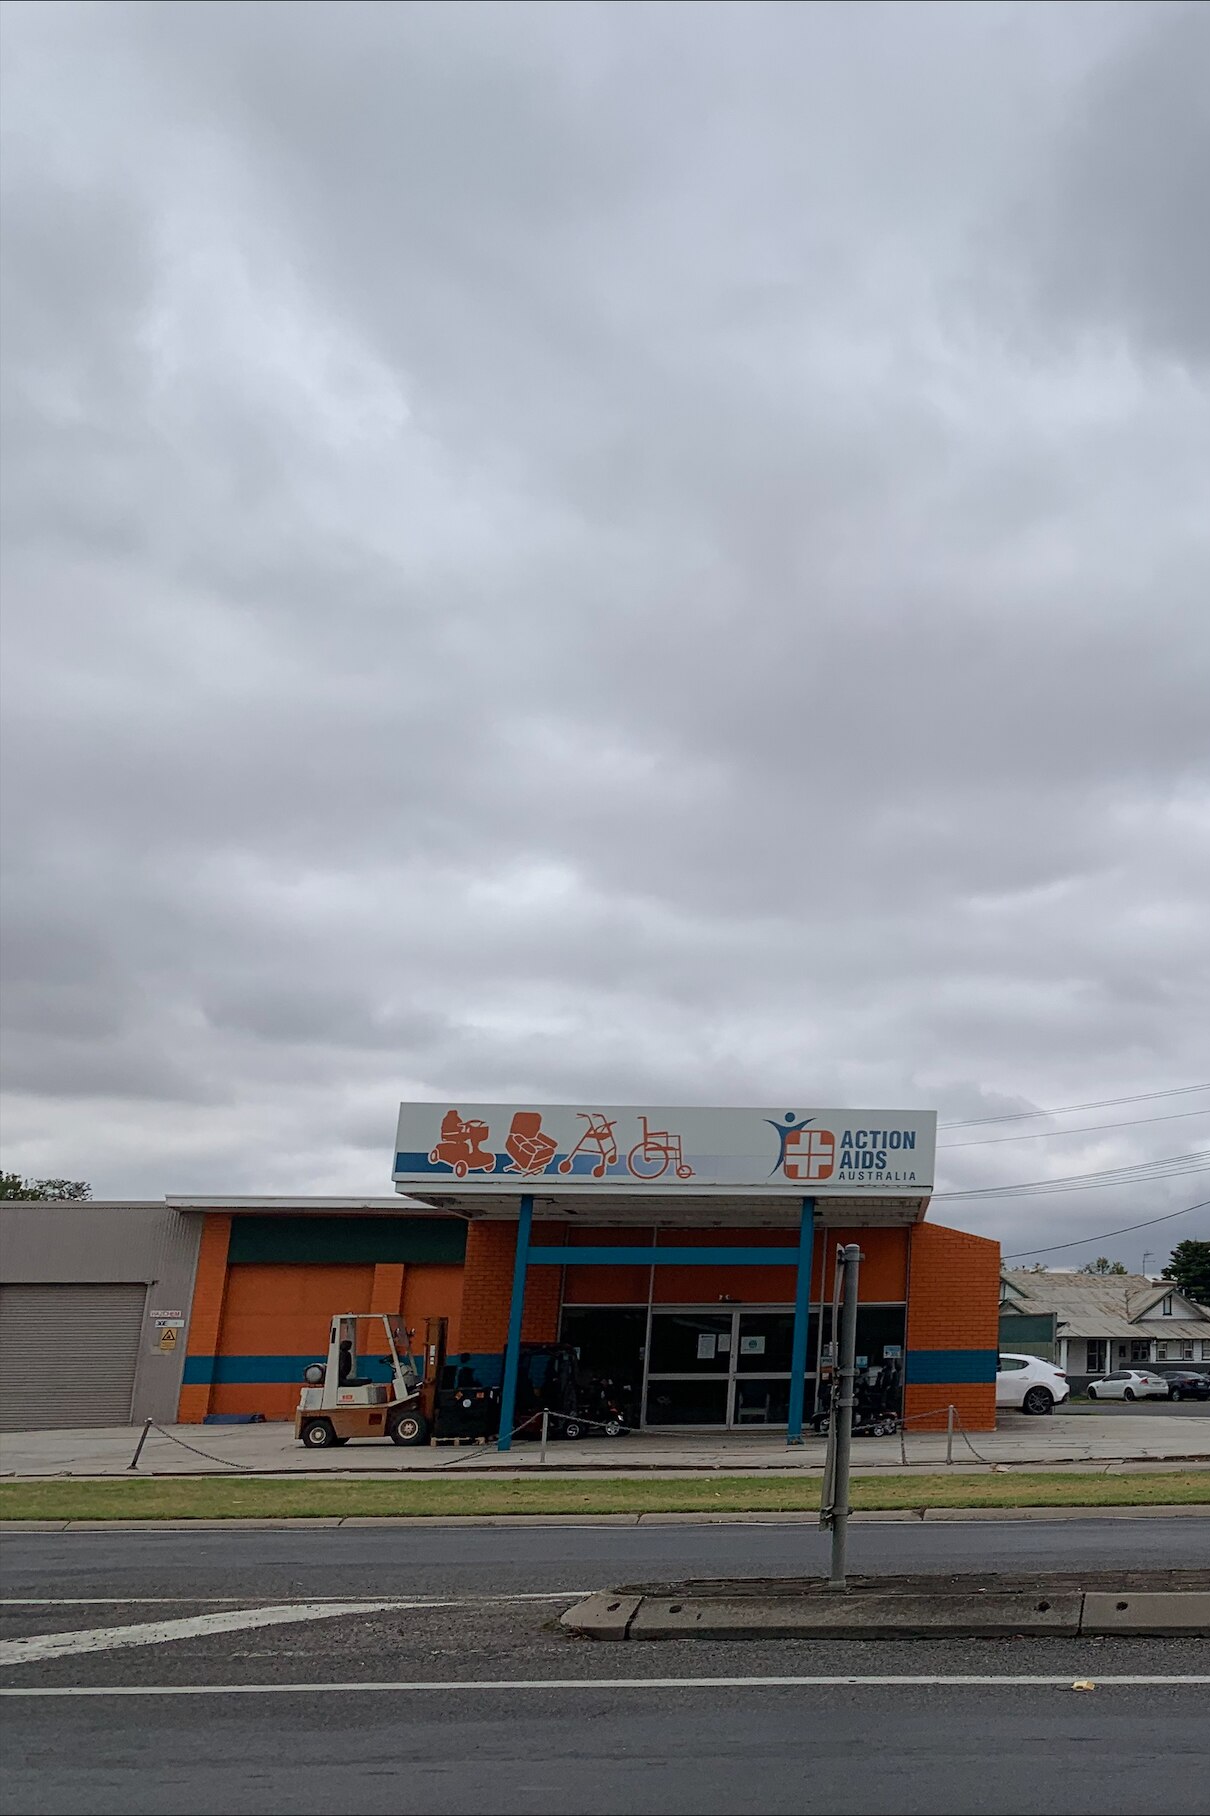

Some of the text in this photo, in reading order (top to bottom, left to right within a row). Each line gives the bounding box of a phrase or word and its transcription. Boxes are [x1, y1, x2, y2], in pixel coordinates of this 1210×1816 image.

[840, 1130, 916, 1149] ACTION
[840, 1150, 887, 1170] AIDS
[838, 1171, 916, 1181] AUSTRALIA
